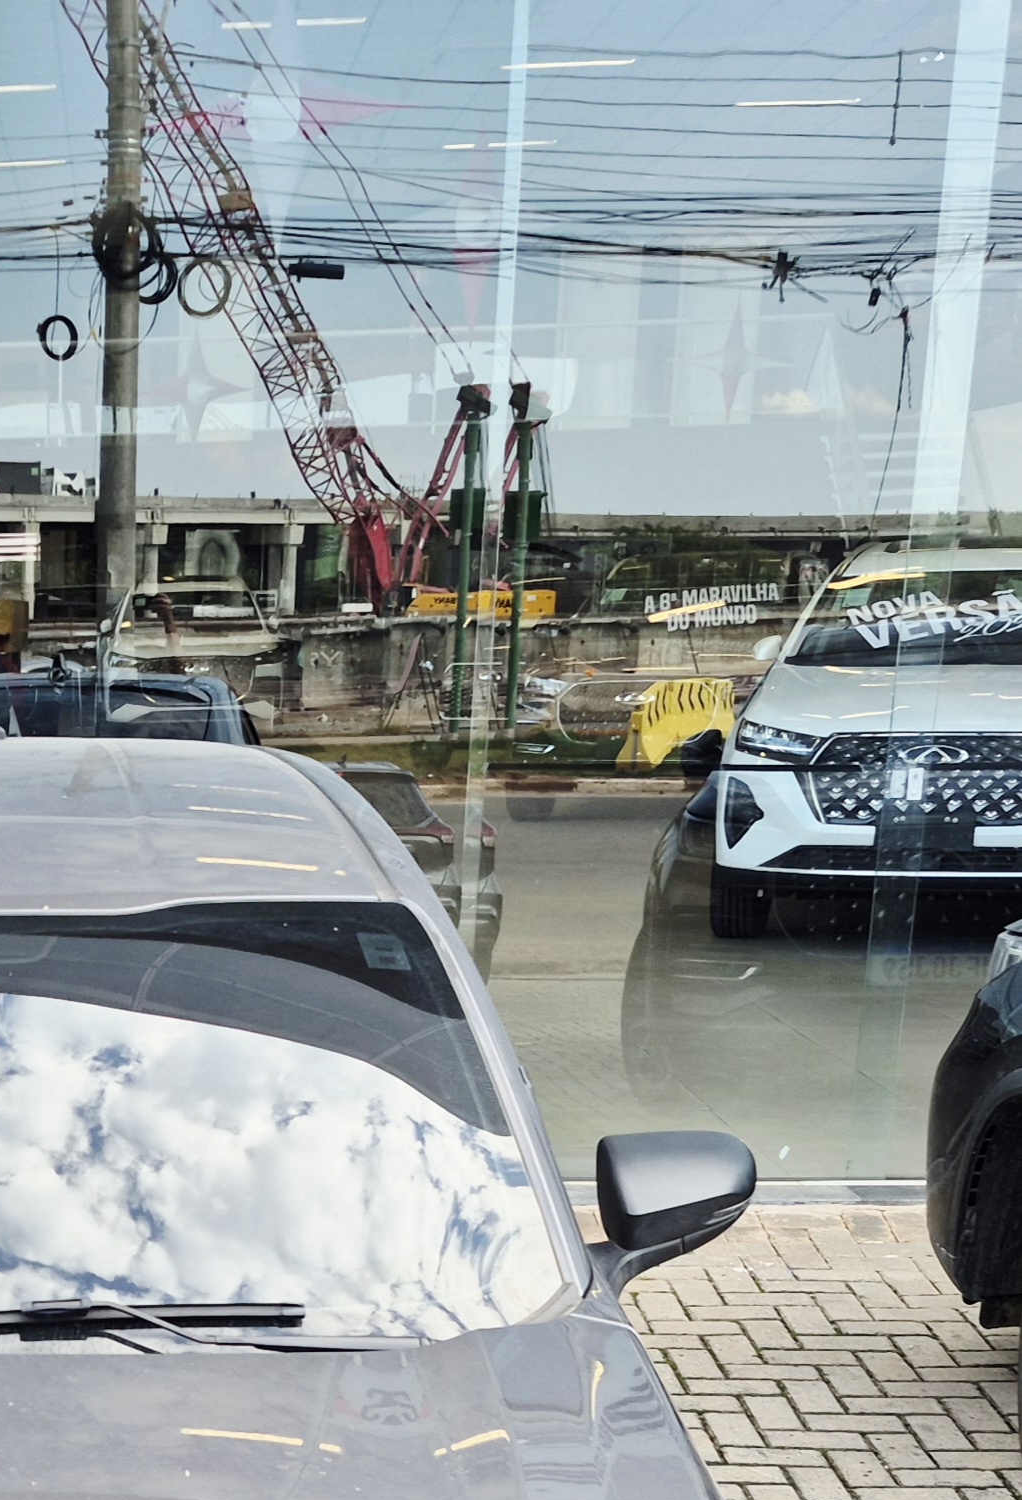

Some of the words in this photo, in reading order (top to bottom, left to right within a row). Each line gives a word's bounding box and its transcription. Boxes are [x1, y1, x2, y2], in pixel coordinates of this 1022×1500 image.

[644, 595, 655, 614] A
[682, 583, 779, 606] MARAVILHA
[846, 591, 944, 626] NOVA
[667, 613, 690, 632] DO
[695, 604, 757, 628] MUNDO
